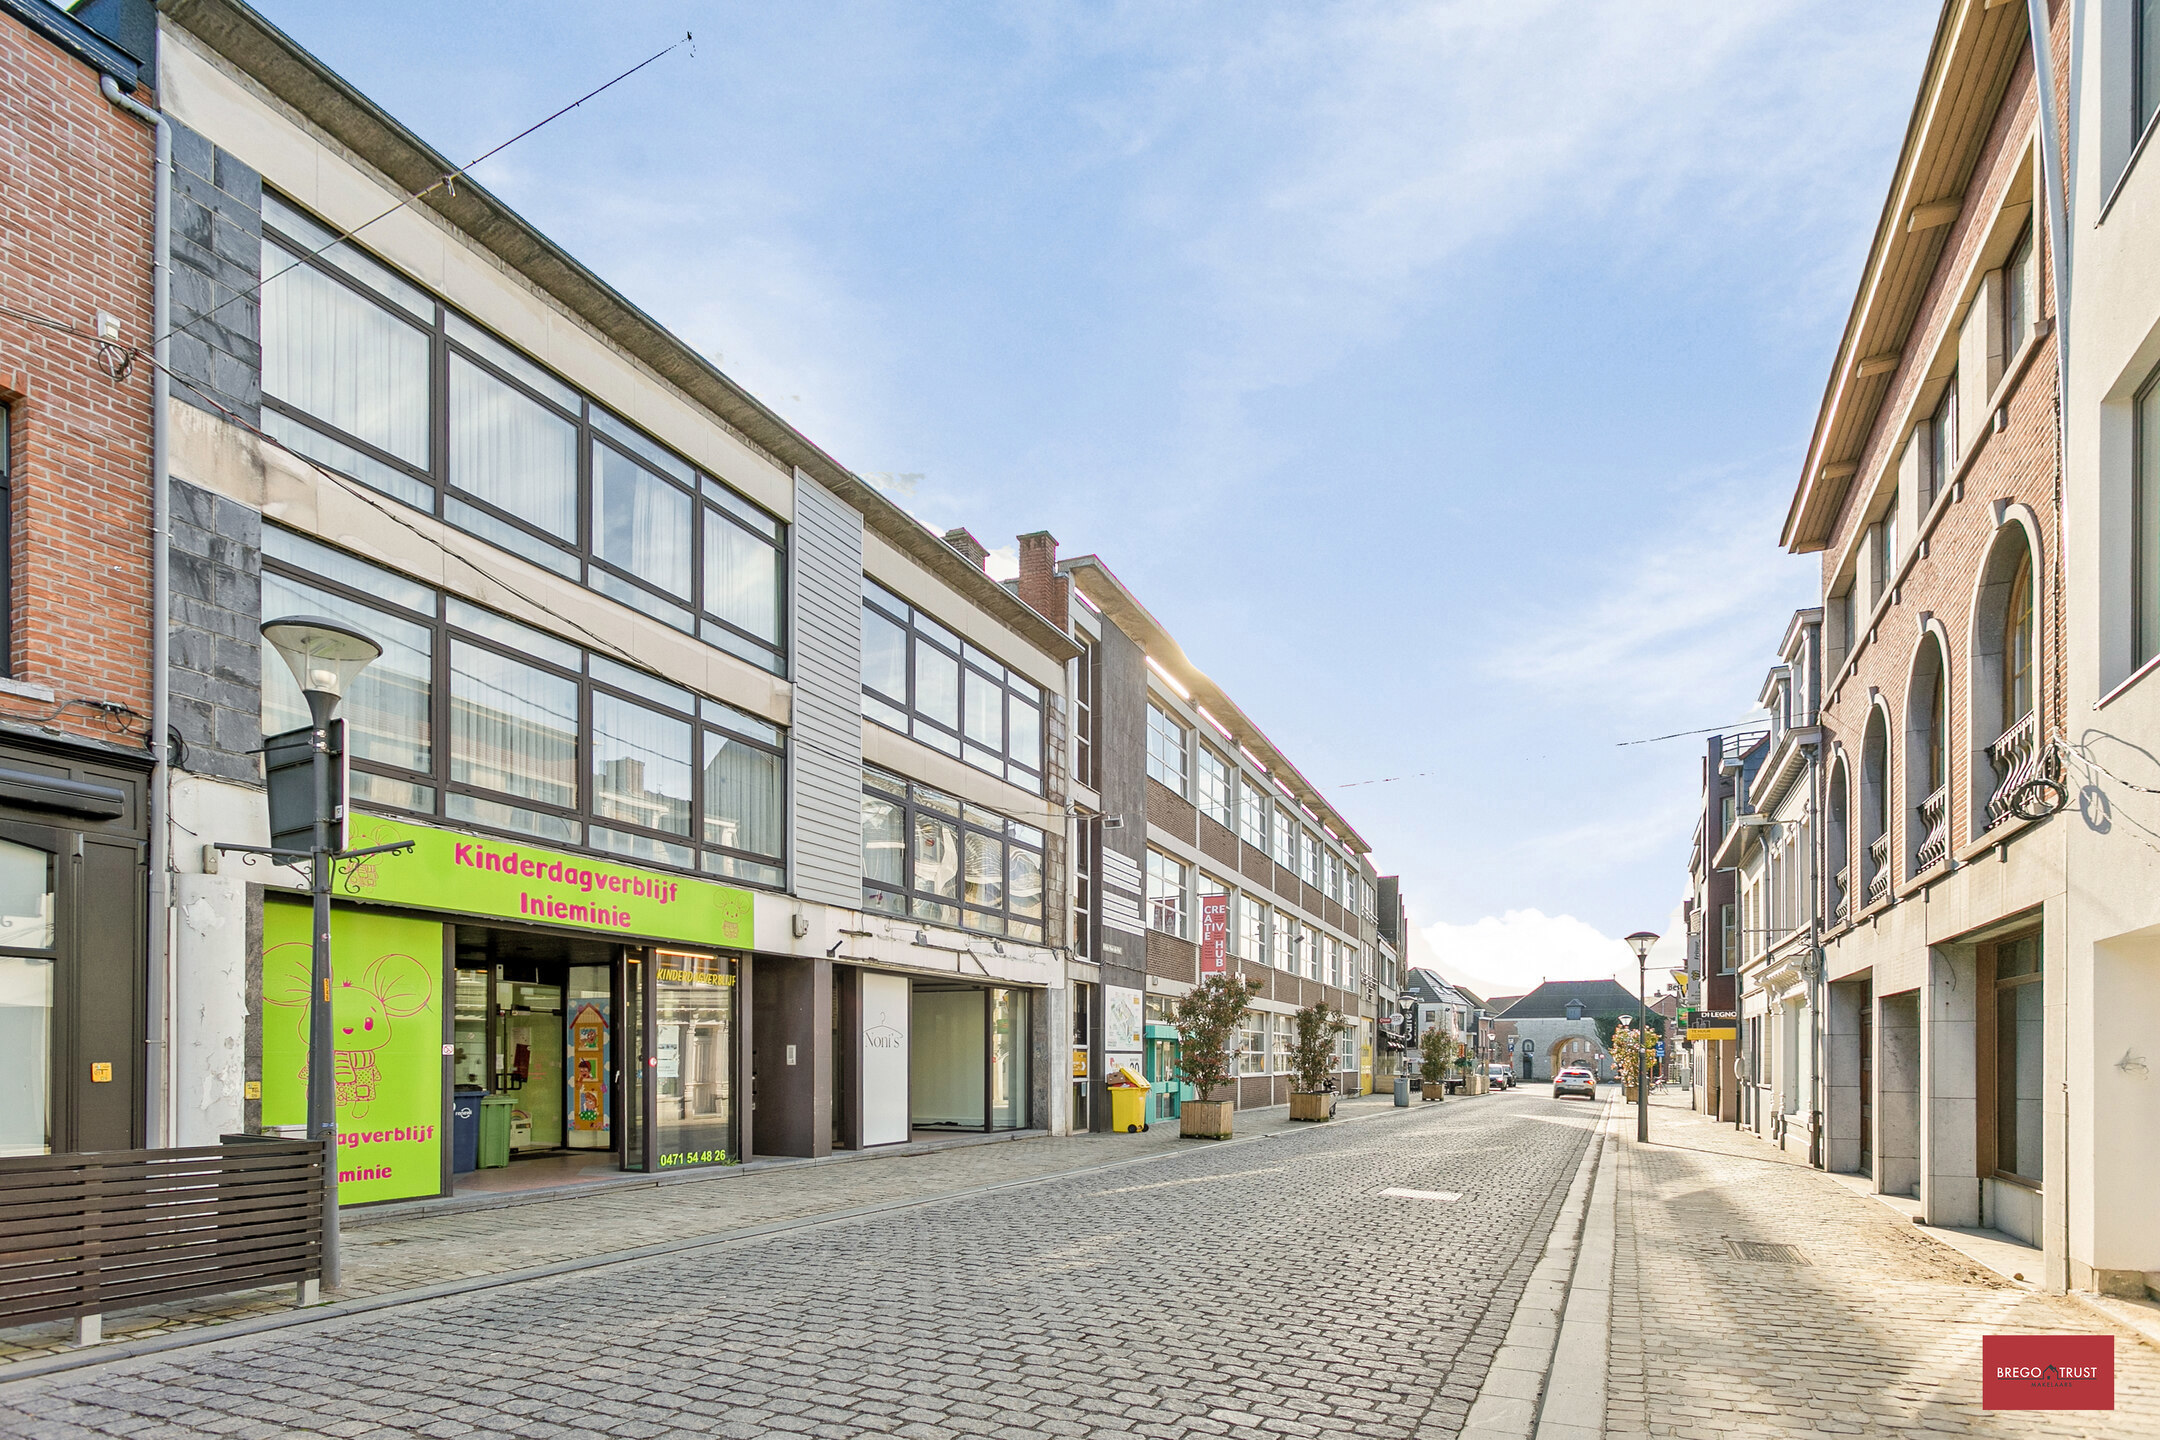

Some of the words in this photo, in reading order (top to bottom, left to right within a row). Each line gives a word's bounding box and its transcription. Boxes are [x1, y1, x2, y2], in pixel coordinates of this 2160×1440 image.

[455, 842, 678, 904] Kinderdagverblijf
[520, 892, 631, 928] Inieminie
[656, 968, 736, 987] KINDERDAGVERBLIJF
[865, 1032, 900, 1048] Noni's
[660, 1153, 684, 1167] 0471
[687, 1151, 699, 1164] 54
[700, 1150, 712, 1162] 48
[714, 1149, 726, 1161] 26
